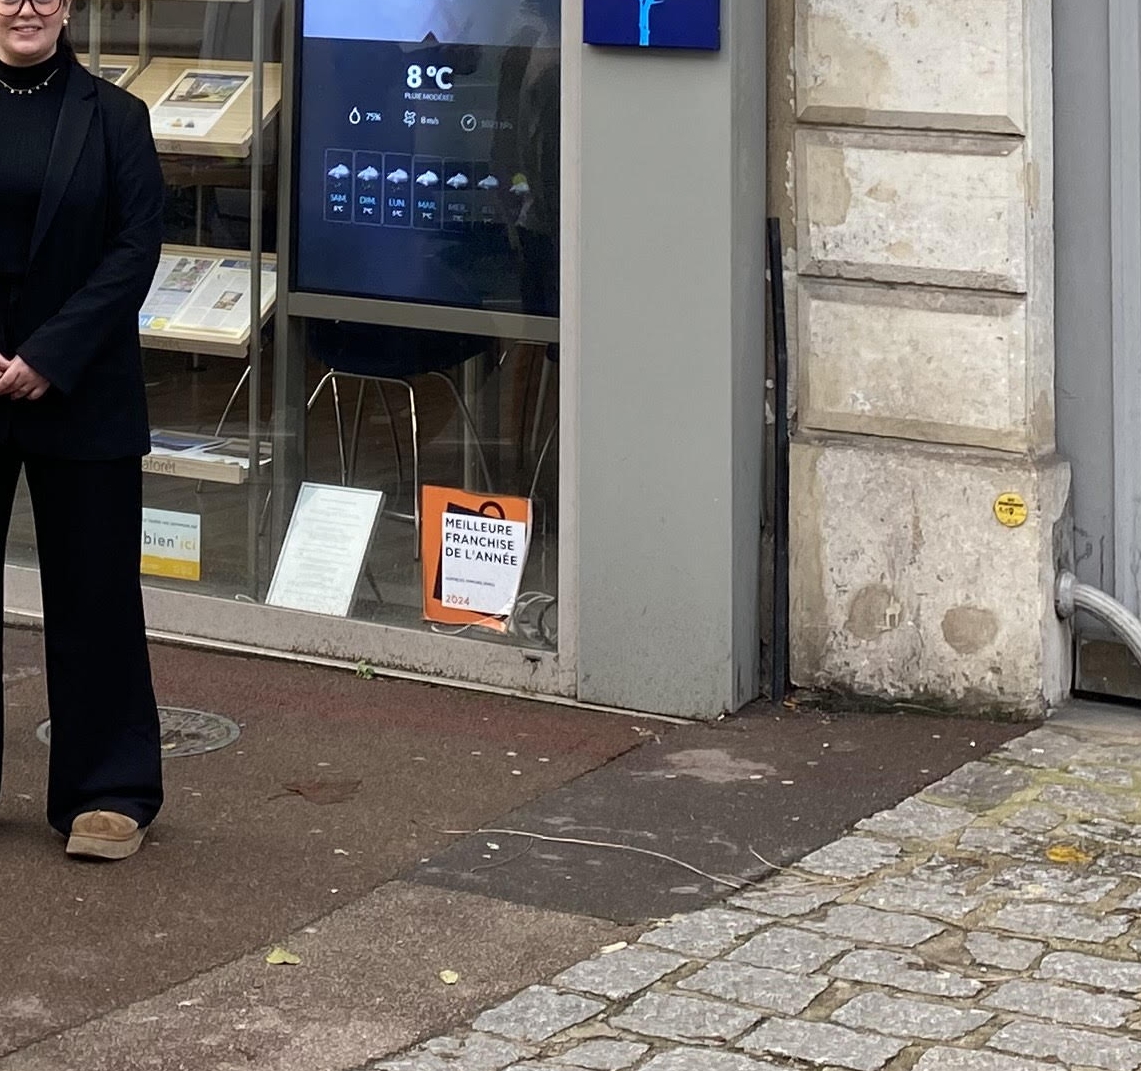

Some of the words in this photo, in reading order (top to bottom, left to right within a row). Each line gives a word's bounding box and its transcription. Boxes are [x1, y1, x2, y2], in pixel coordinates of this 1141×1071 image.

[142, 456, 175, 474] aforêt
[445, 517, 513, 536] MEILLEURE
[445, 532, 514, 551] FRANCHISE
[445, 547, 462, 558] DE
[465, 549, 518, 566] L'ANNÉE
[445, 594, 470, 606] 2024
